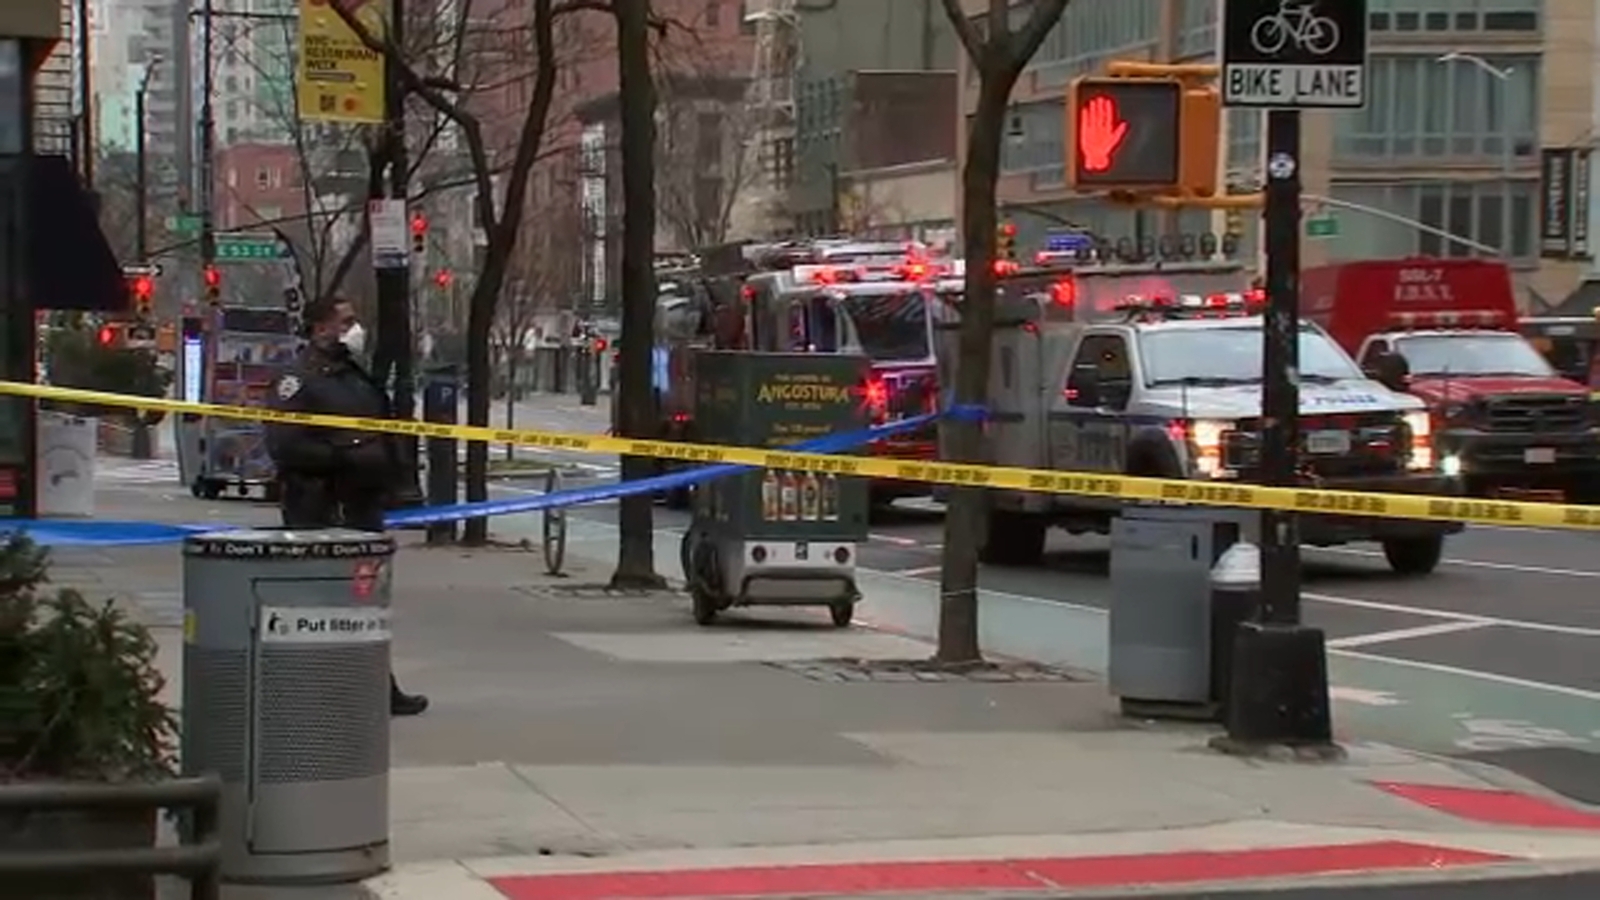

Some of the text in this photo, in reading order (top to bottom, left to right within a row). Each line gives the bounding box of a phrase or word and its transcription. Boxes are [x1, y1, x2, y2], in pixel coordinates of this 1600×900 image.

[1229, 68, 1358, 97] BIKE LANE
[756, 383, 851, 404] ANGOSTURA
[225, 543, 264, 555] Don't
[297, 618, 326, 632] Put
[329, 618, 365, 633] litter
